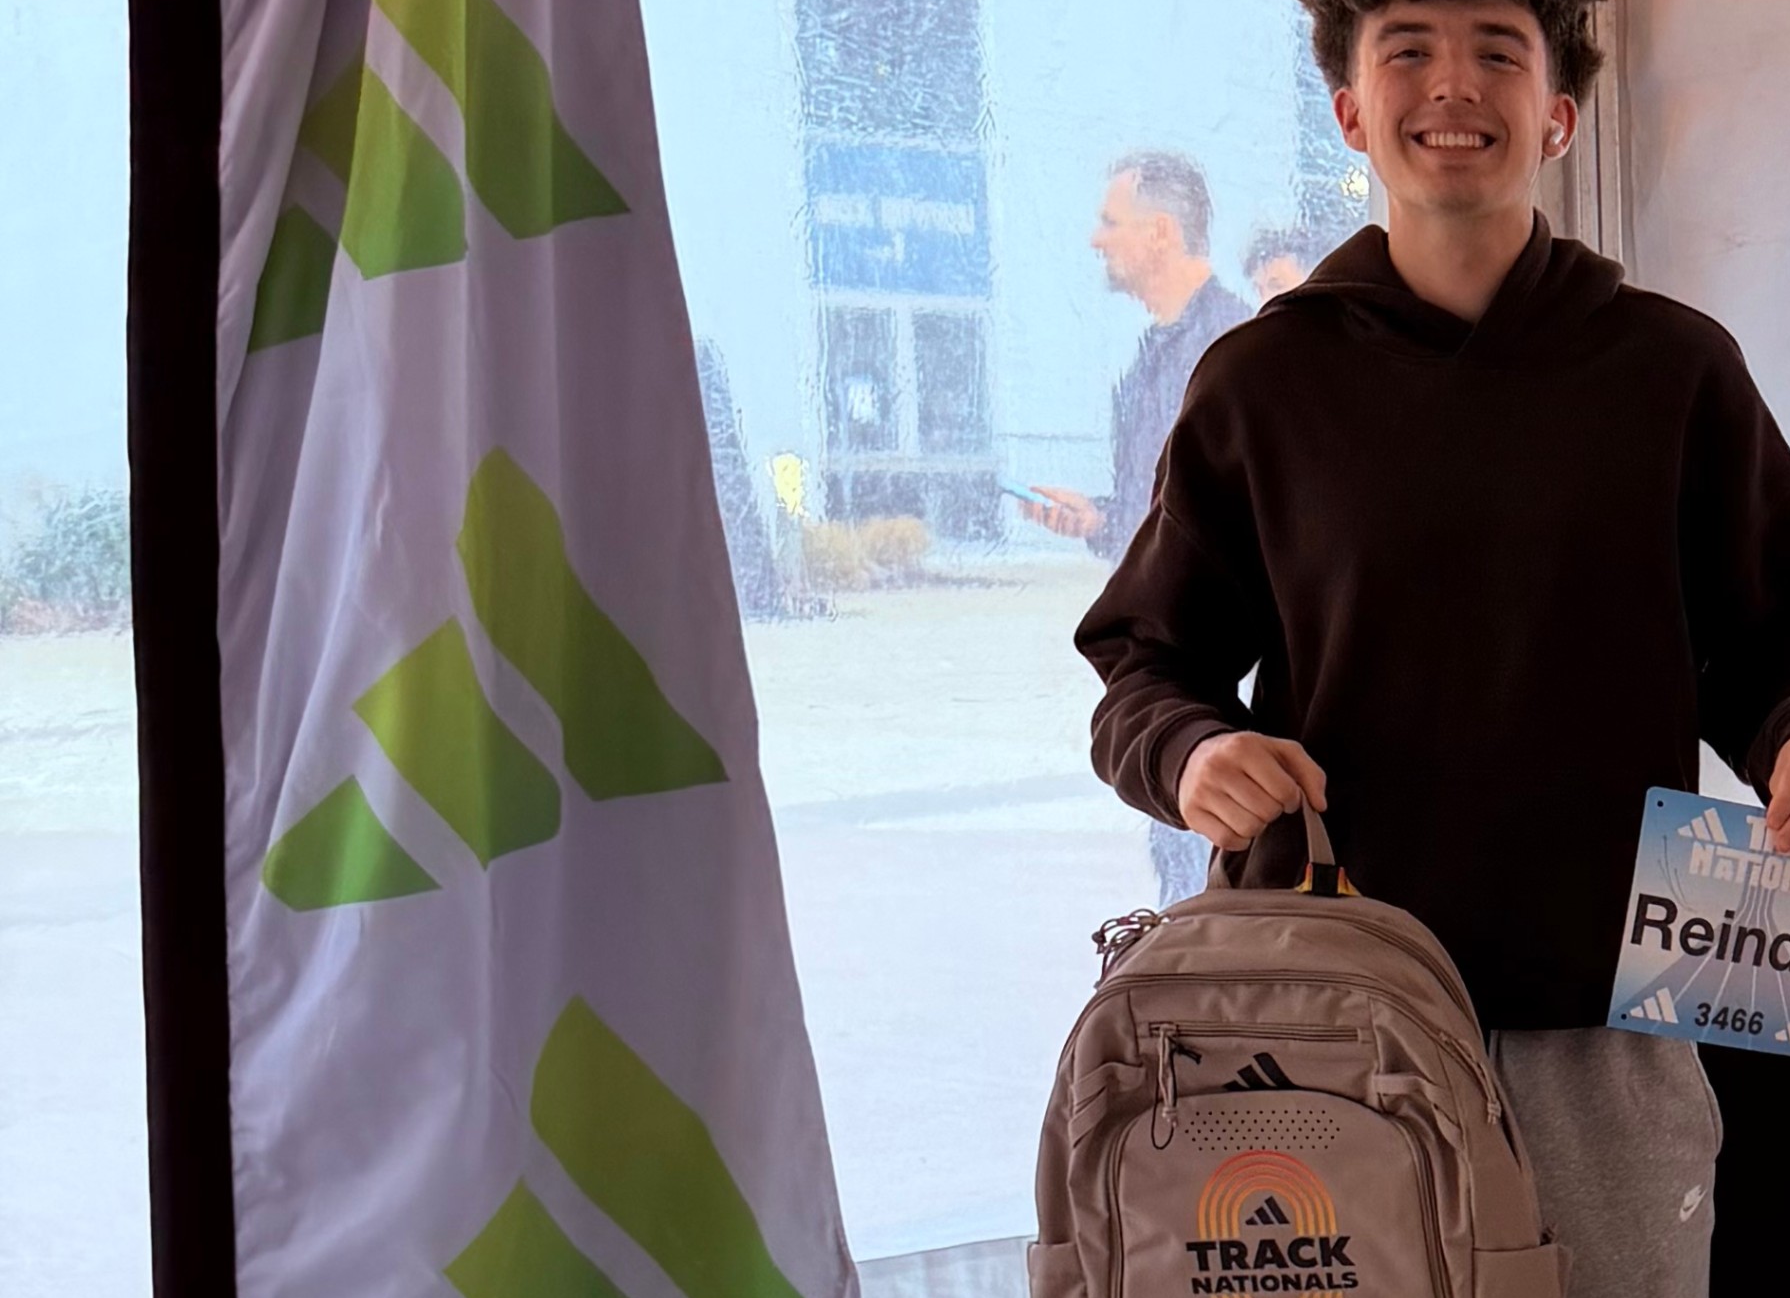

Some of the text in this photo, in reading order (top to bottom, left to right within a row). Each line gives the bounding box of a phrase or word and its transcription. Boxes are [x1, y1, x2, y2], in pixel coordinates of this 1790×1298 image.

[1694, 1003, 1765, 1035] 3466
[1186, 1235, 1356, 1273] TRACK
[1191, 1271, 1360, 1294] NATIONALS
